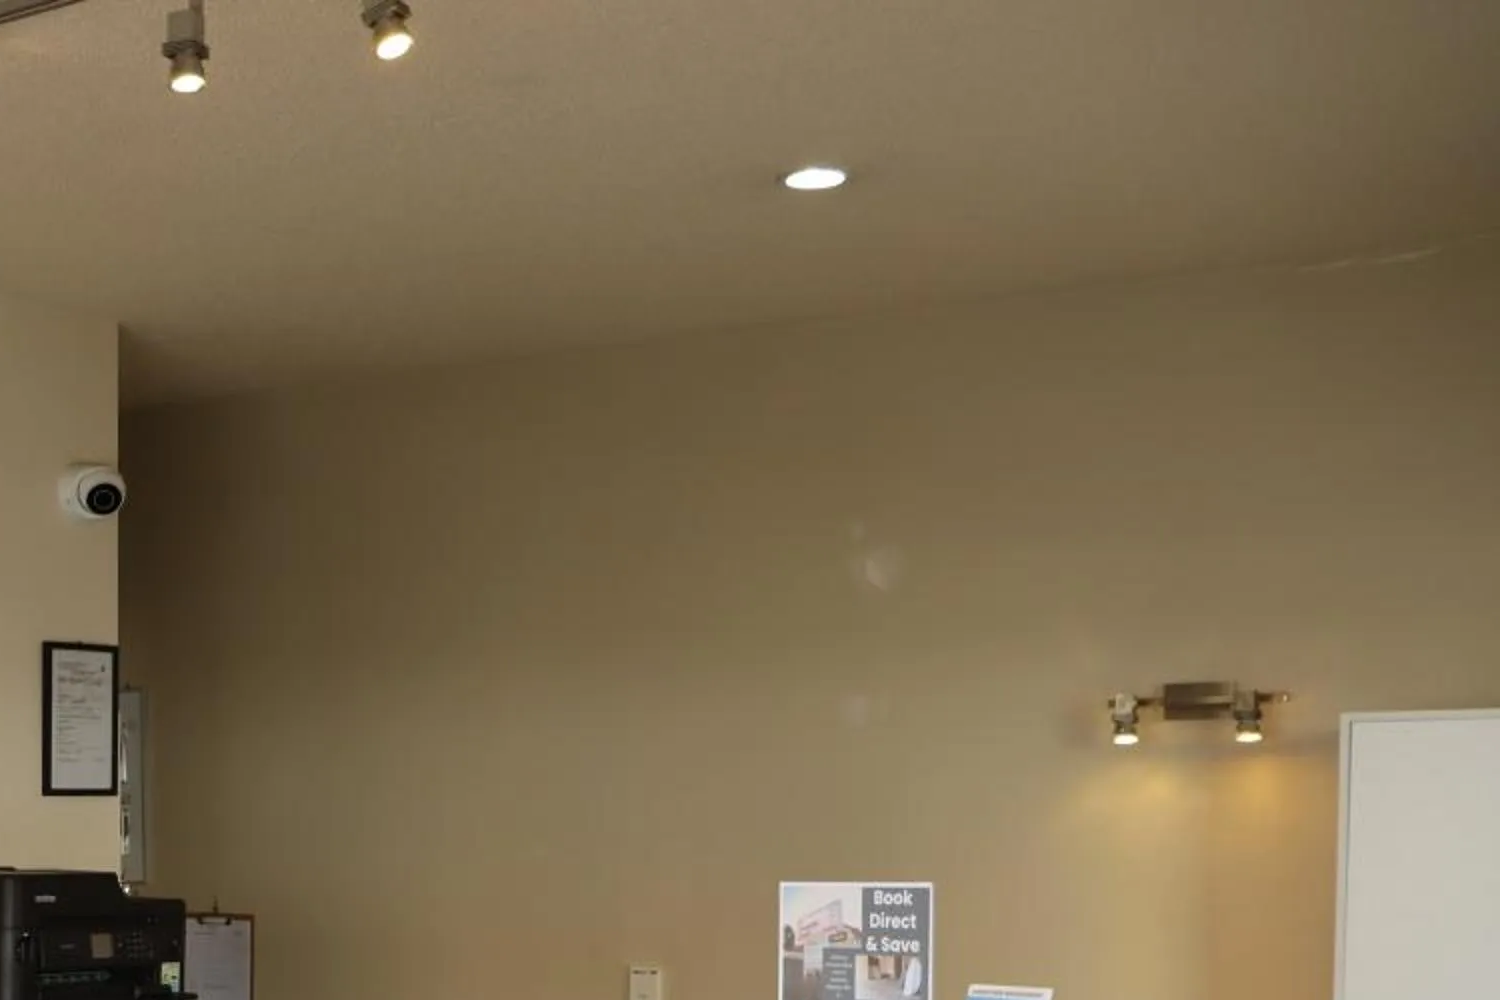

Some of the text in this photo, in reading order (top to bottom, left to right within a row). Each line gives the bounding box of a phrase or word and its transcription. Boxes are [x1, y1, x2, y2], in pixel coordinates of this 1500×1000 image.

[873, 890, 913, 906] Book
[869, 911, 917, 929] Direct
[866, 936, 920, 953] & Save
